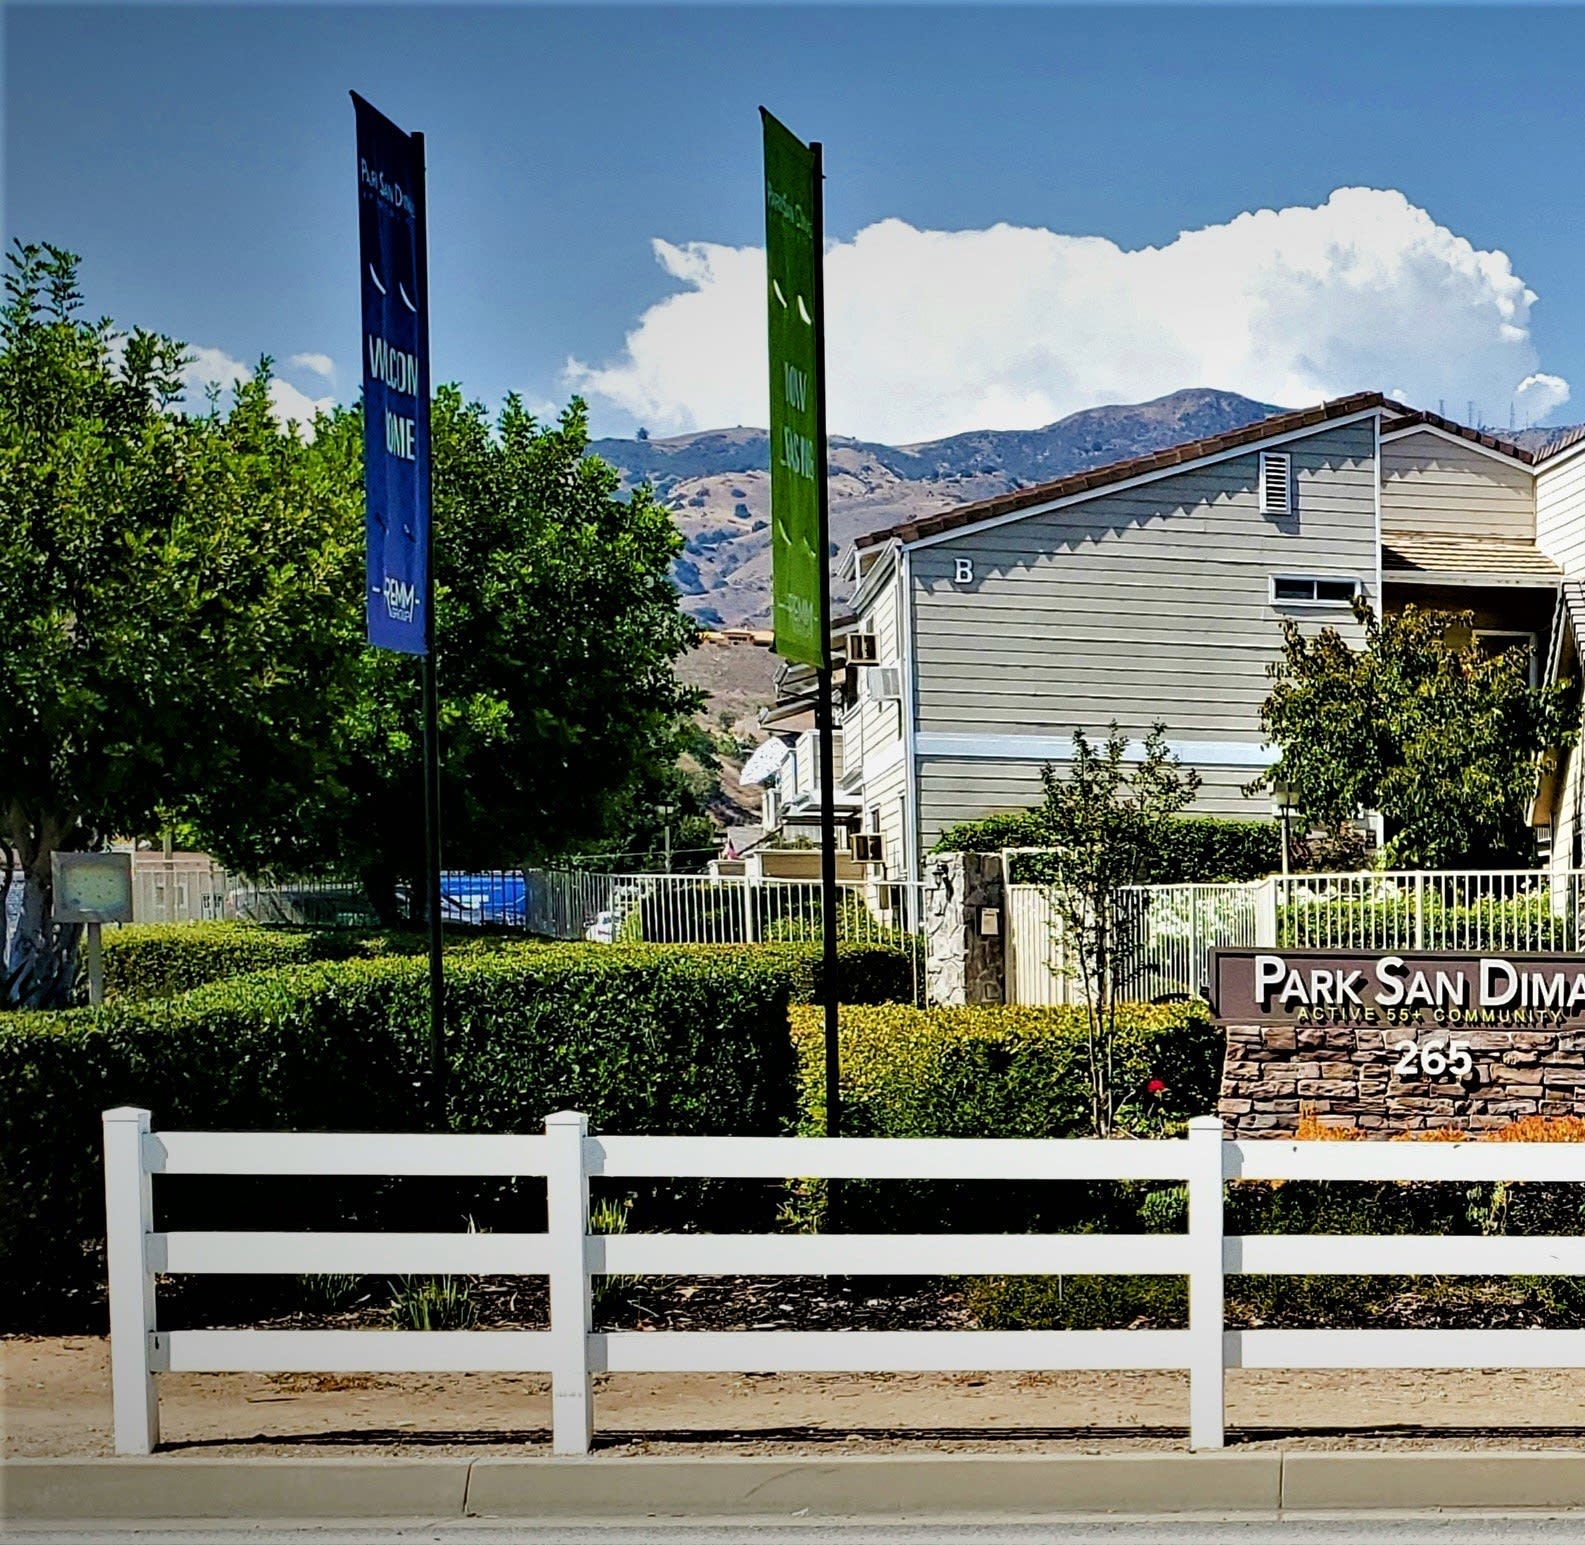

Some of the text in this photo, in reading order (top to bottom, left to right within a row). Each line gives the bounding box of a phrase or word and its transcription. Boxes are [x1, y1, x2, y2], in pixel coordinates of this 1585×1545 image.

[954, 558, 974, 583] B
[1254, 955, 1363, 1005] PARK
[1374, 956, 1464, 1007] SAN
[1297, 1007, 1566, 1024] ACTIVE 55+ COMMUNITY
[1394, 1038, 1473, 1077] 265
